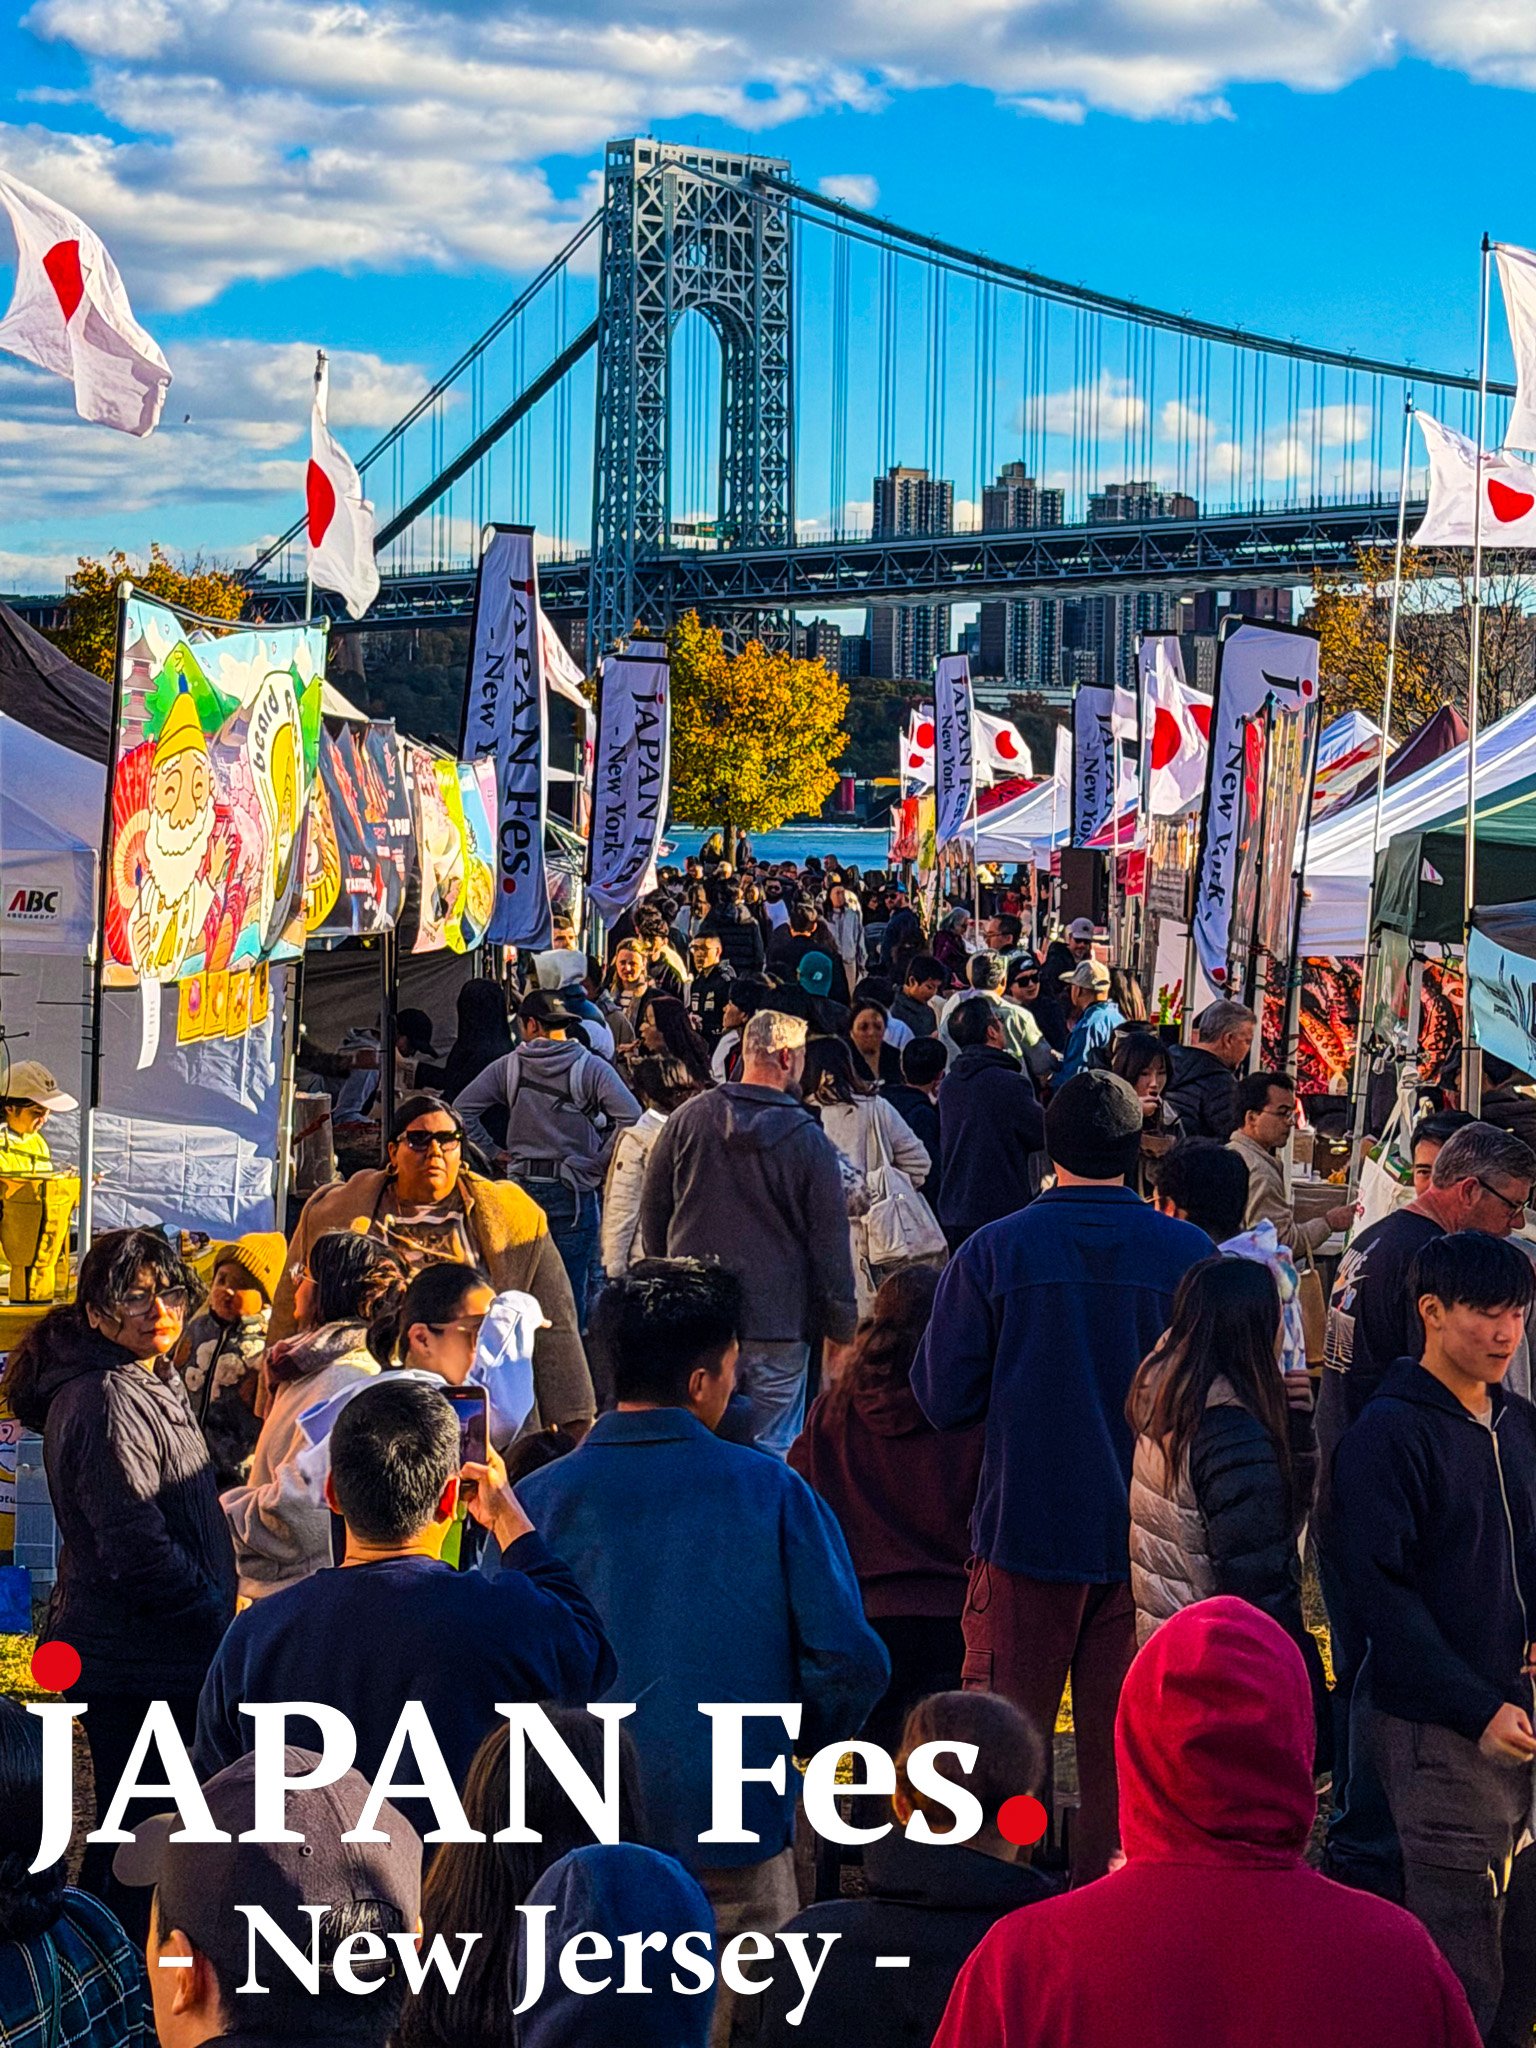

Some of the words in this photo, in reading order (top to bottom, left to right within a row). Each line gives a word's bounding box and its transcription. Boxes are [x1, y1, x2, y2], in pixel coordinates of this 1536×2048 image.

[480, 651, 505, 729] New
[508, 576, 539, 774] JAPAN
[253, 684, 279, 773] beard
[631, 690, 665, 828] JAPAN
[941, 714, 954, 748] New
[951, 675, 972, 767] JAPAN
[608, 743, 627, 796] New
[942, 756, 956, 795] York
[1083, 757, 1100, 805] New
[1217, 740, 1245, 821] New
[501, 785, 539, 894] Fes.
[602, 802, 626, 857] York
[8, 890, 58, 913] ABC
